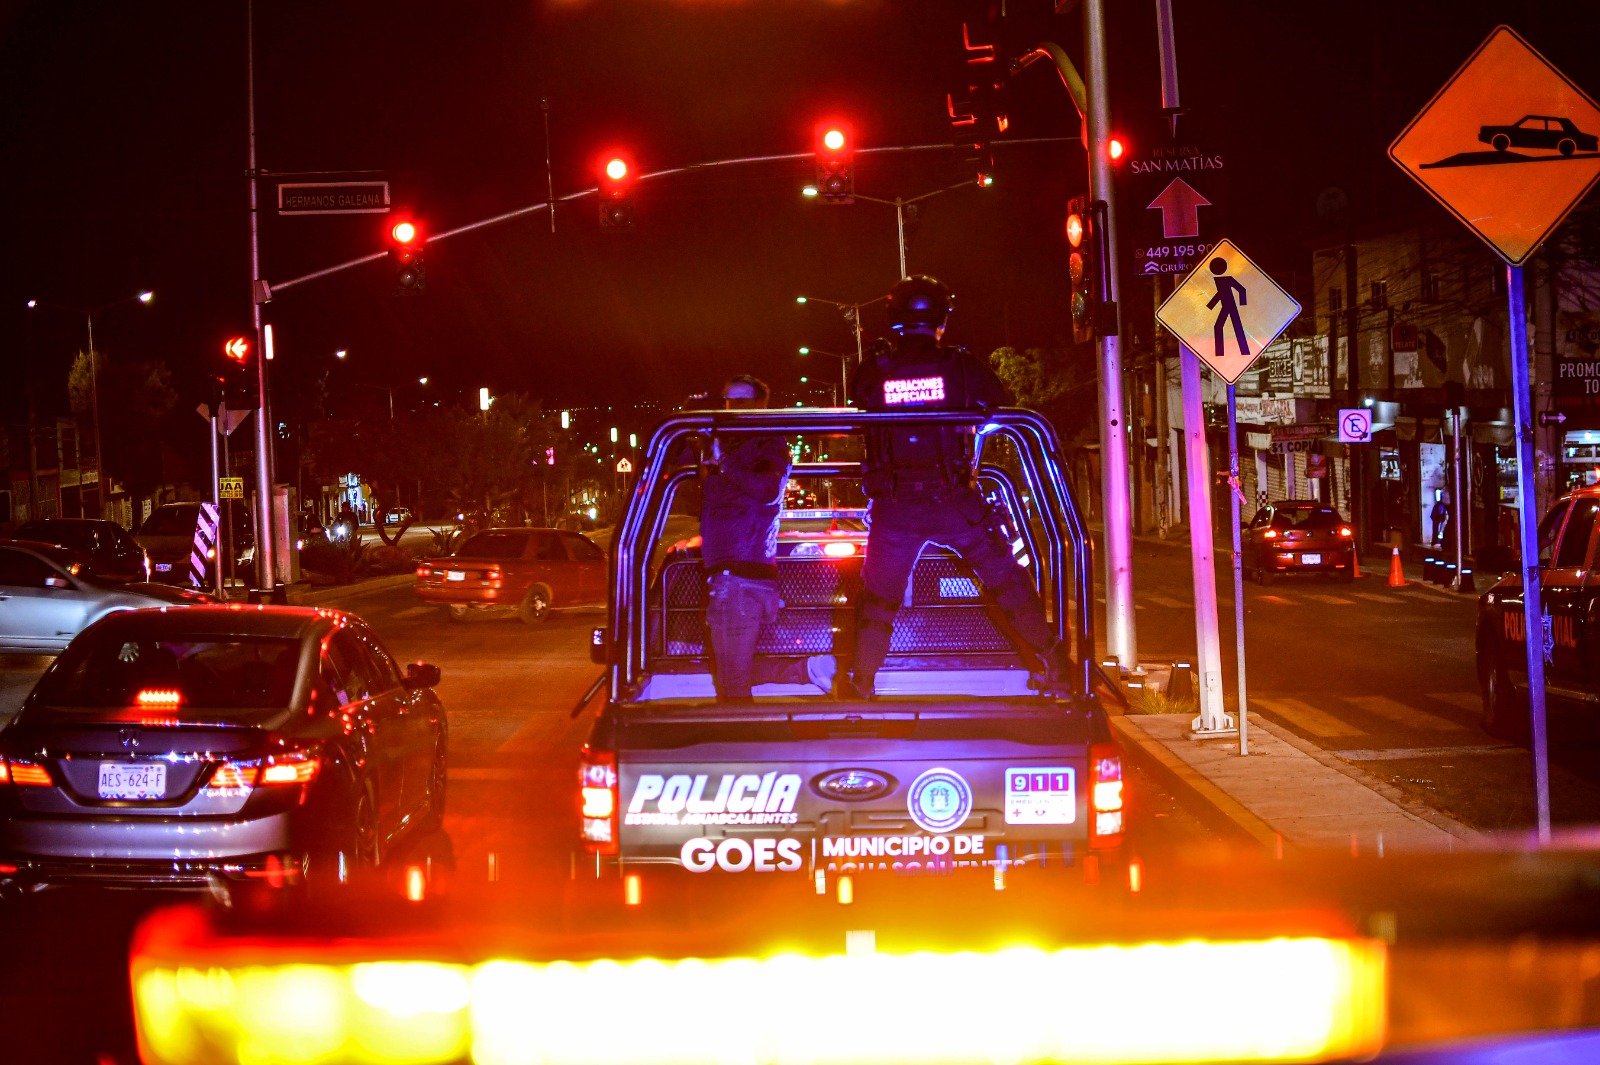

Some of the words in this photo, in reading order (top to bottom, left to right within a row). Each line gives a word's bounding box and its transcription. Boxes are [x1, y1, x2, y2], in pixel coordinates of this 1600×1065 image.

[1153, 147, 1201, 157] RESERVA
[1131, 160, 1162, 174] SAN
[1165, 154, 1224, 172] MATÍAS
[286, 194, 336, 208] HERMANOS
[338, 193, 381, 207] GALEANA
[1146, 246, 1170, 258] 449
[1173, 245, 1195, 257] 195
[1160, 263, 1194, 273] GRUPO
[884, 377, 944, 393] OPERACIONES
[885, 388, 945, 404] ESPECIALES
[102, 773, 162, 787] AES-624-F
[1013, 775, 1066, 792] 911
[627, 771, 802, 813] POLICÍA
[681, 812, 798, 825] AGUASCALIENTES
[822, 836, 950, 857] MUNICIPIO
[954, 834, 984, 855] DE
[680, 837, 802, 873] GOES
